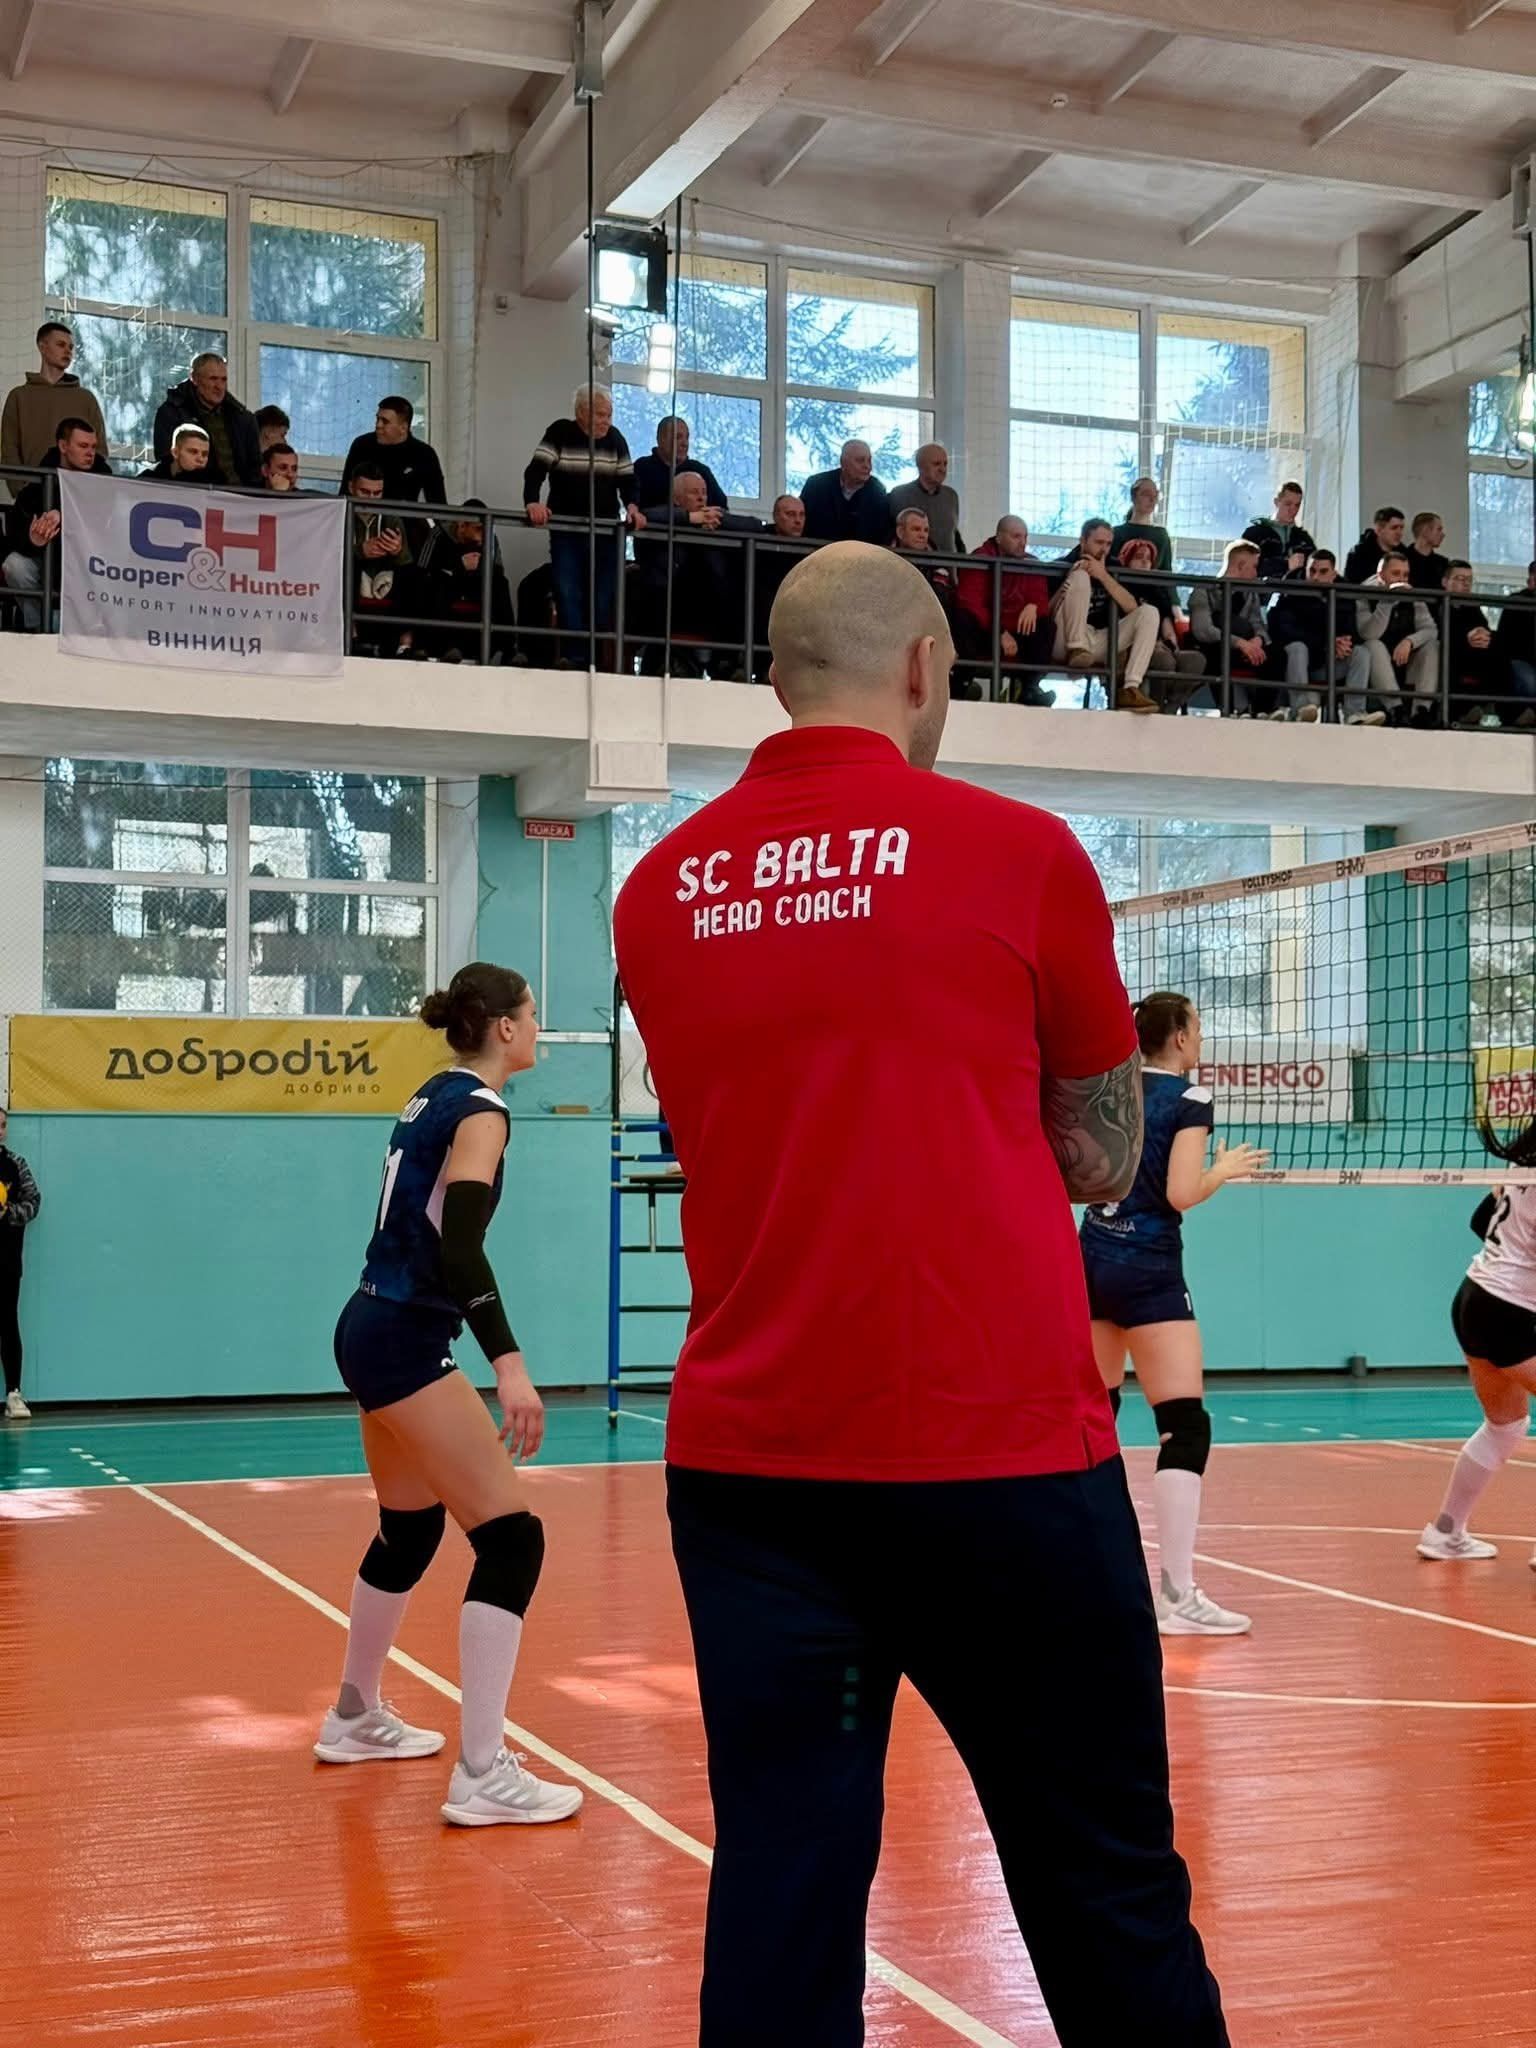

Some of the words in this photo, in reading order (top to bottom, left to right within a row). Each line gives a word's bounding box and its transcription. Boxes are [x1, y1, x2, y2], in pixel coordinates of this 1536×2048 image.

[129, 501, 278, 572] CH
[88, 555, 185, 588] Cooper
[229, 573, 321, 598] Hunter
[86, 591, 176, 611] COMFORT
[190, 606, 320, 624] INNOVATIONS
[147, 630, 262, 656] ВІННИЦЯ
[675, 850, 732, 902] SC
[753, 827, 910, 889] BALTA
[693, 899, 763, 940] HEAD
[774, 885, 872, 926] COACH
[284, 1081, 382, 1097] добриво
[1198, 1062, 1325, 1089] ENERGO
